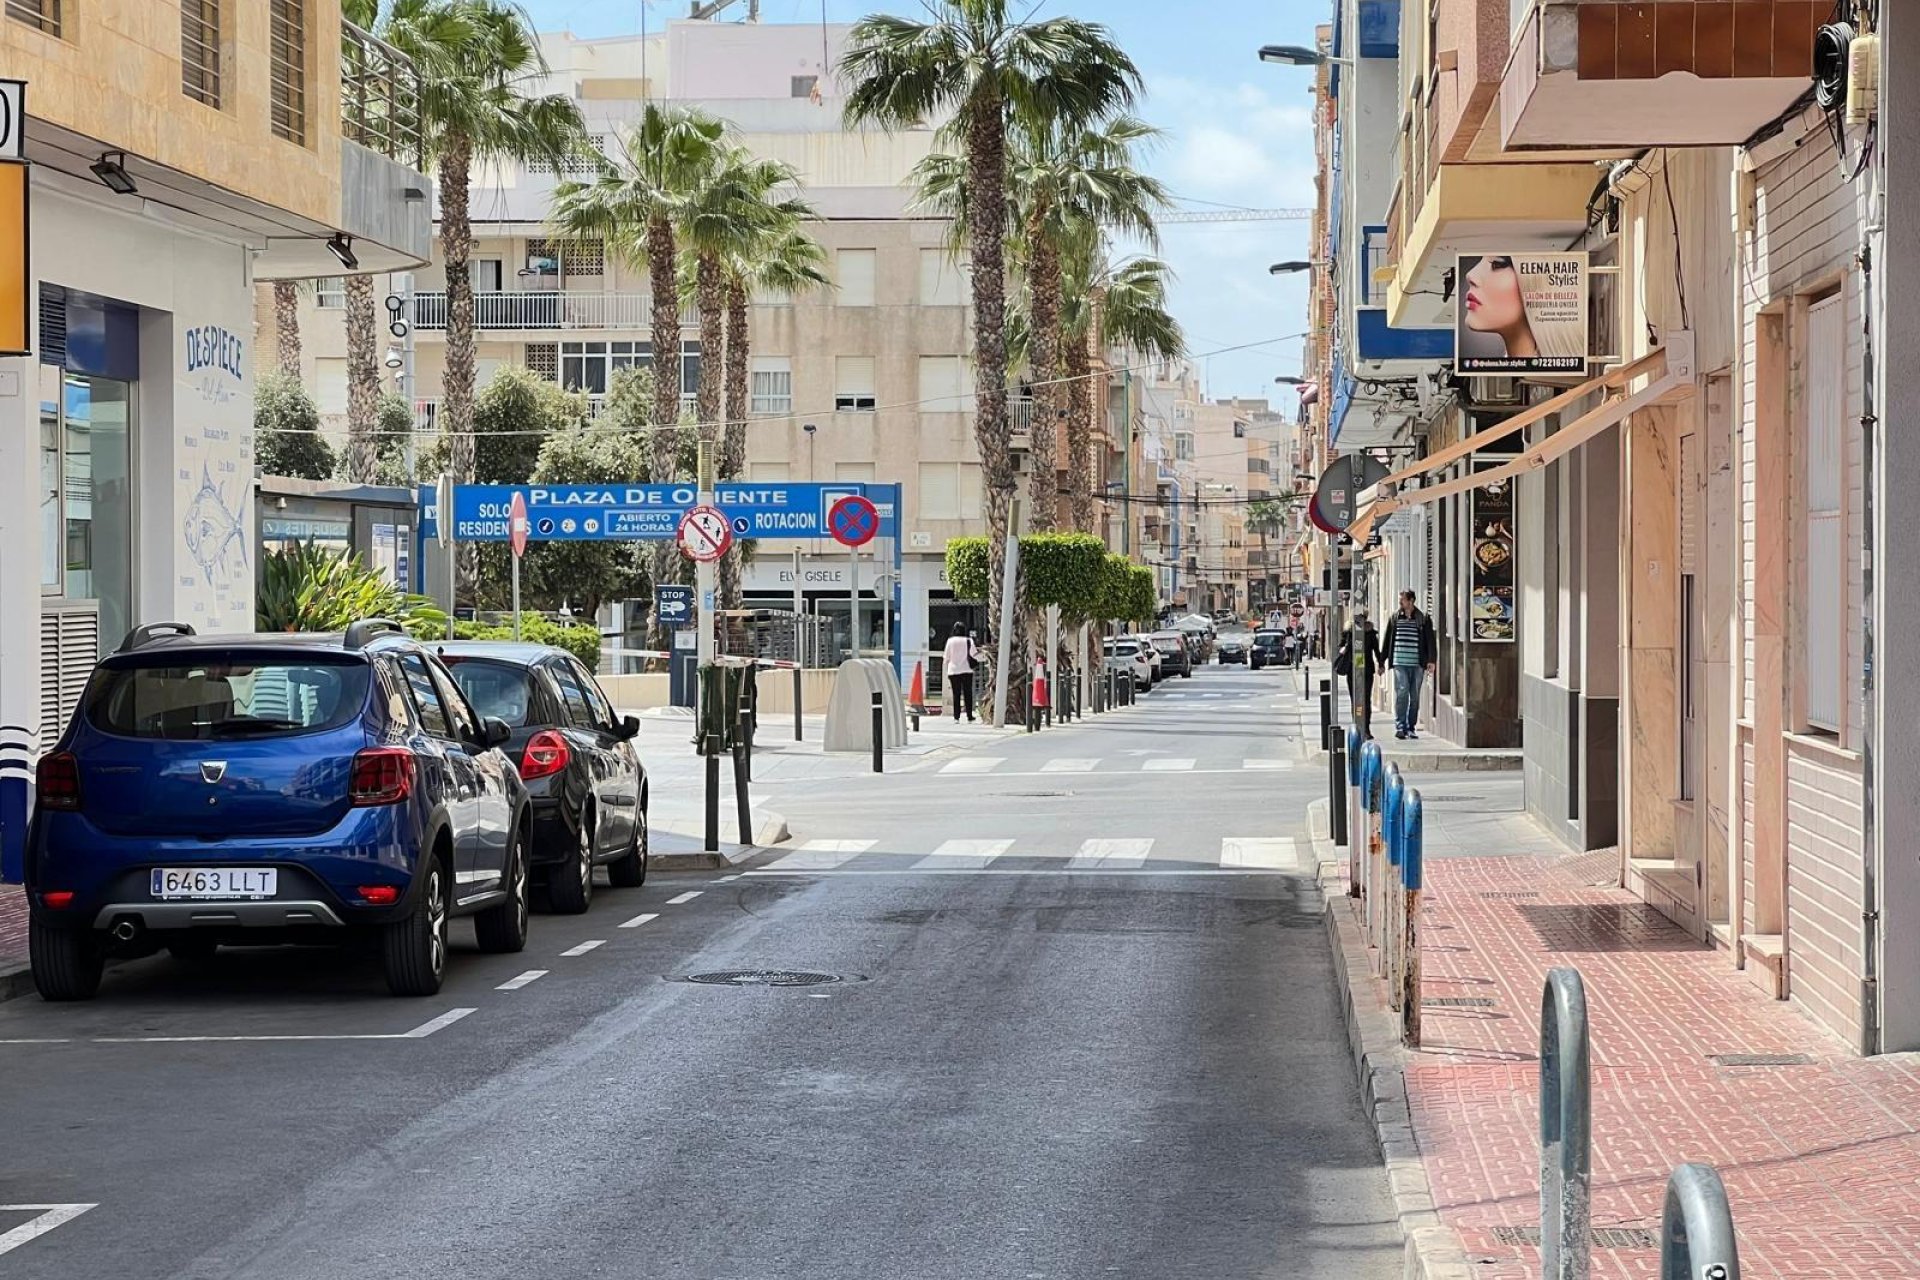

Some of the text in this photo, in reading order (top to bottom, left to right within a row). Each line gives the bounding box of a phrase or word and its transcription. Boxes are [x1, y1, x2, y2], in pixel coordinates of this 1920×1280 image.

[1520, 261, 1579, 275] ELENA HAIR
[1548, 274, 1579, 287] Stylist
[1553, 291, 1578, 300] BELLEZA
[186, 325, 242, 381] DESPIECE
[530, 488, 788, 505] PLAZA DE OIENTE
[479, 503, 511, 518] SOLO
[617, 513, 672, 522] ABIERTO
[615, 523, 674, 532] 24 HORAS
[755, 512, 817, 530] ROTACION
[459, 521, 532, 536] RESIDENS
[804, 571, 841, 581] GISELE
[661, 591, 685, 599] STOP
[166, 872, 221, 892] 6463
[229, 872, 270, 892] LLT
